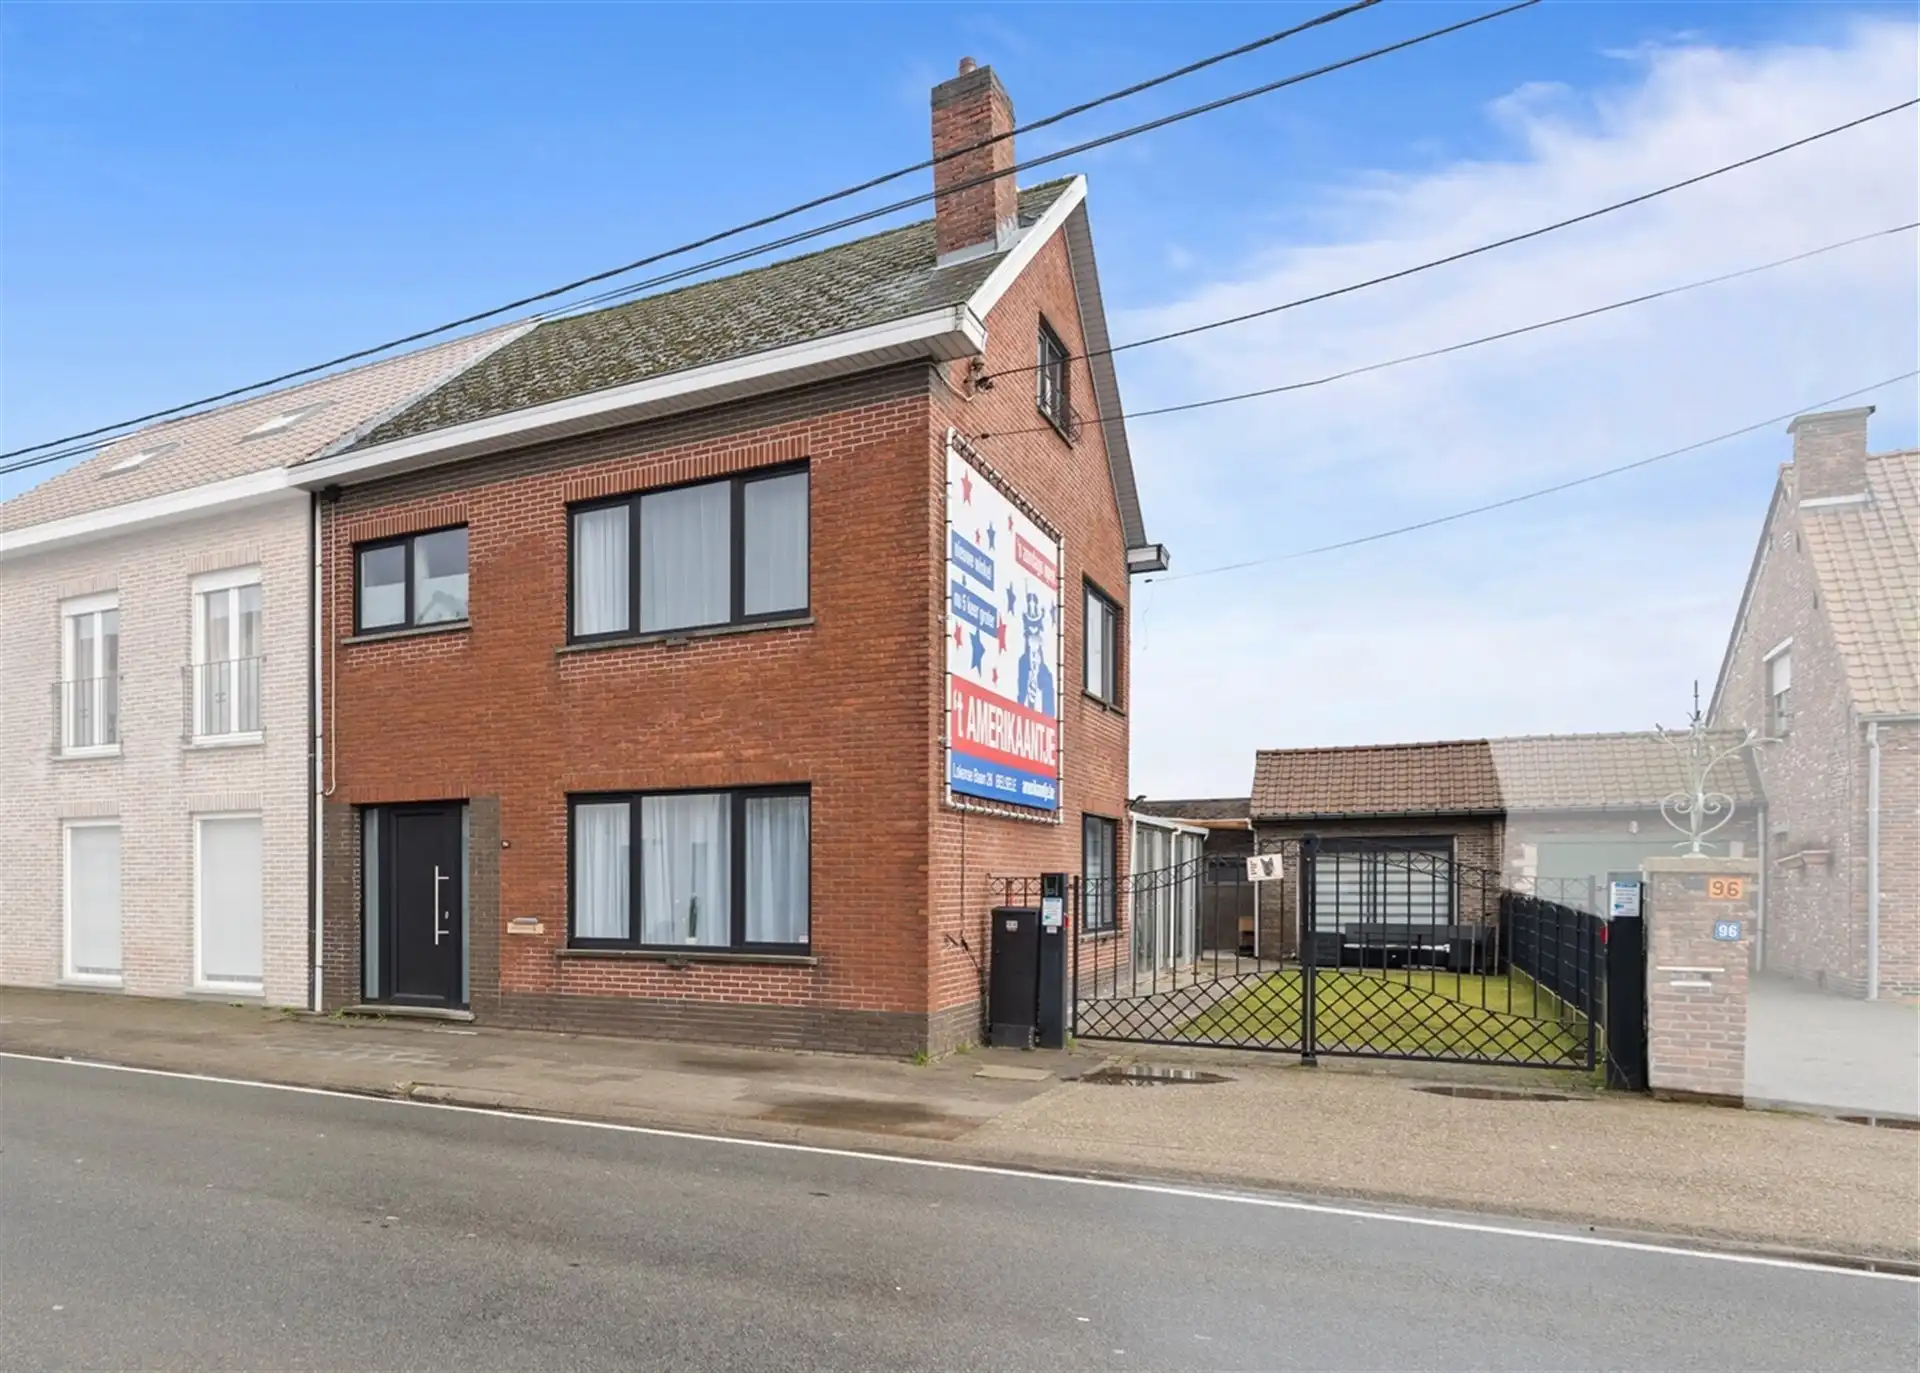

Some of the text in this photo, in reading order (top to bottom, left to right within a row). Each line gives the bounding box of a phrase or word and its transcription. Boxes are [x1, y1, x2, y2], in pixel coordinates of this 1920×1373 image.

[966, 695, 1057, 768] AMERIKAANTJE
[1712, 880, 1739, 897] 96
[1719, 924, 1737, 938] 96
